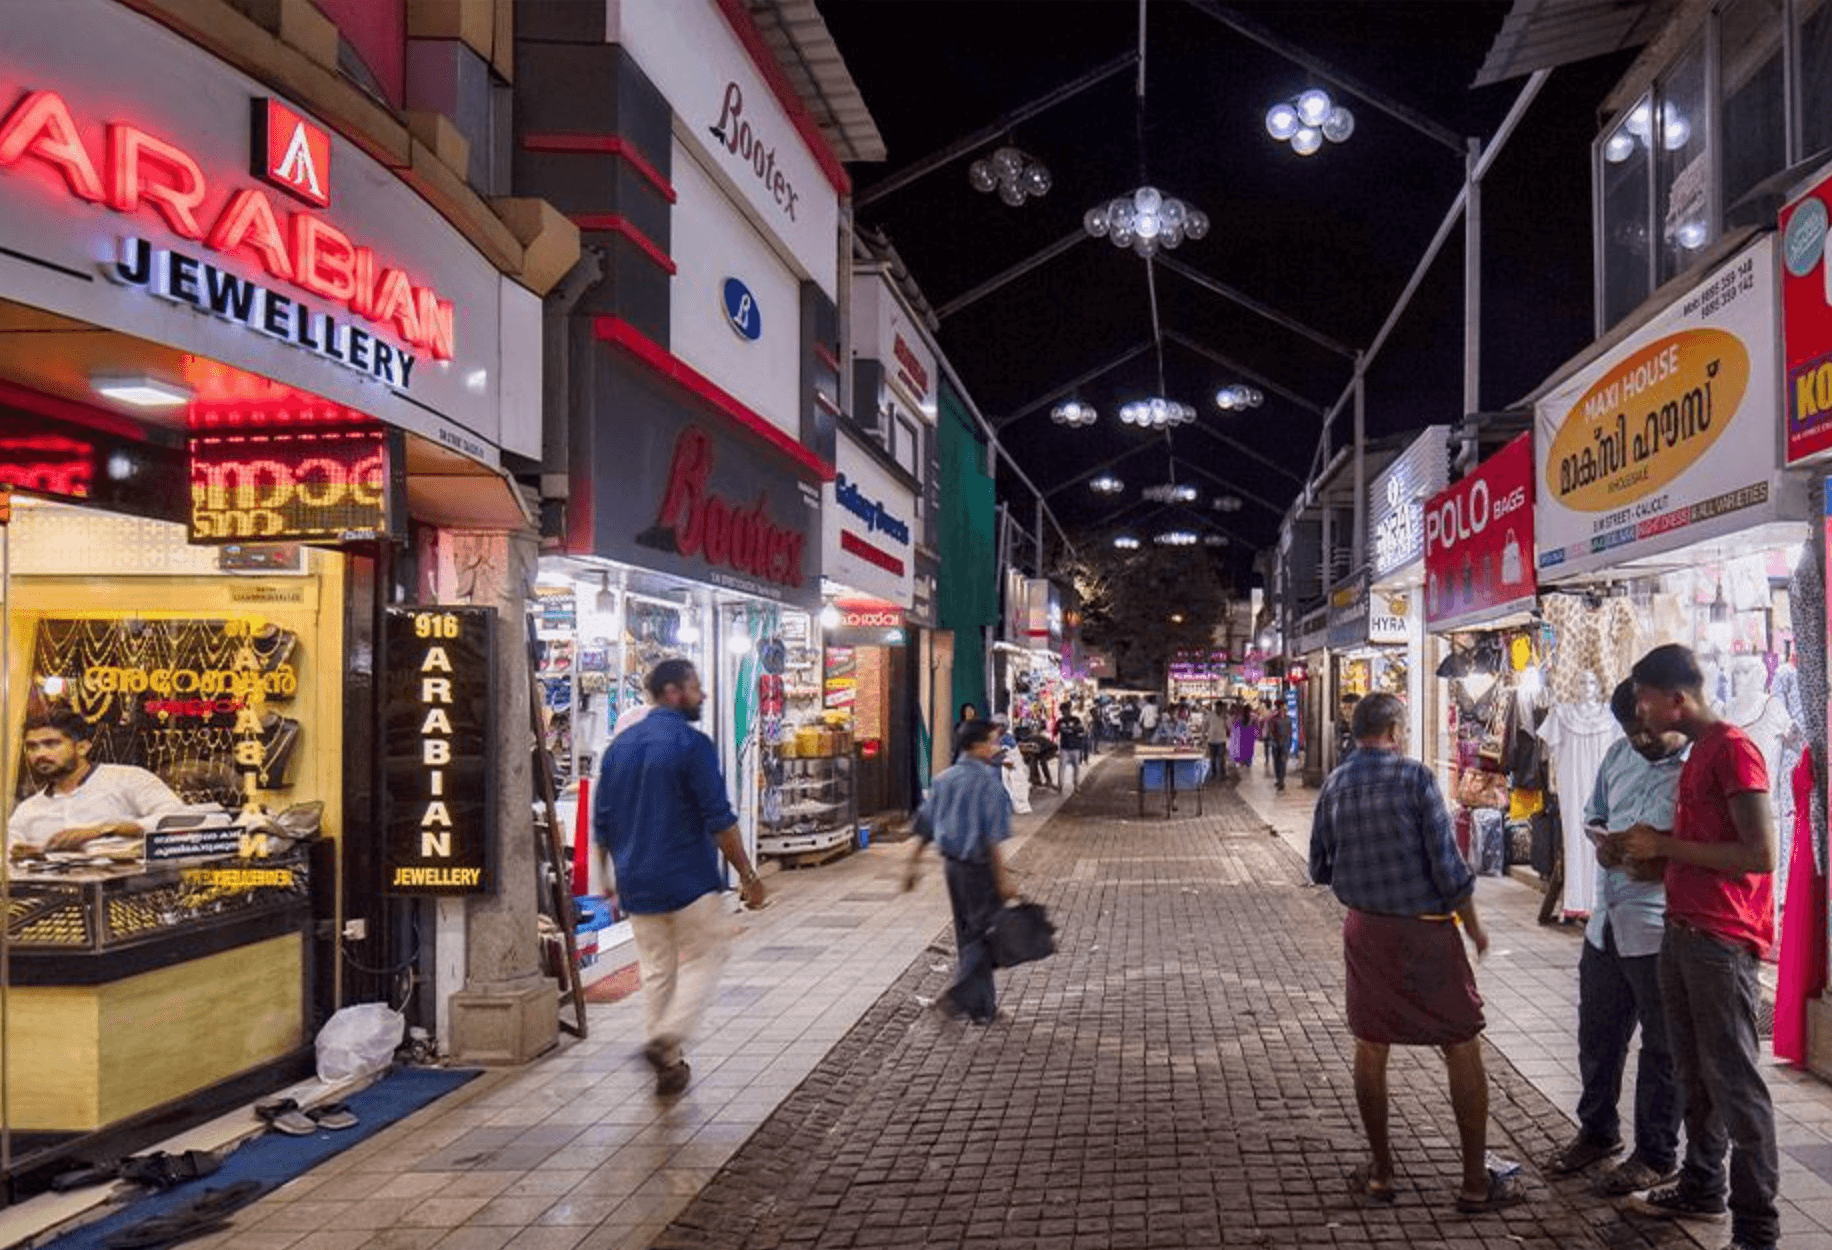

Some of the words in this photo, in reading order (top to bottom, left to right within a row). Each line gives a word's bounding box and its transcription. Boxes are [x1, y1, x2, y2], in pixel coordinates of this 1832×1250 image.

[709, 82, 799, 222] Bootex
[0, 90, 455, 361] ARABIAN
[114, 237, 416, 390] JEWELLERY
[1584, 382, 1619, 424] MAXI
[1623, 343, 1680, 402] HOUSE
[645, 424, 807, 588] Bootex
[1427, 479, 1490, 558] POLO
[1493, 486, 1526, 521] BAGS
[414, 614, 460, 639] 916
[1371, 616, 1406, 632] HYRA
[420, 646, 453, 858] ARABIAN
[393, 866, 481, 887] JEWELLERY
